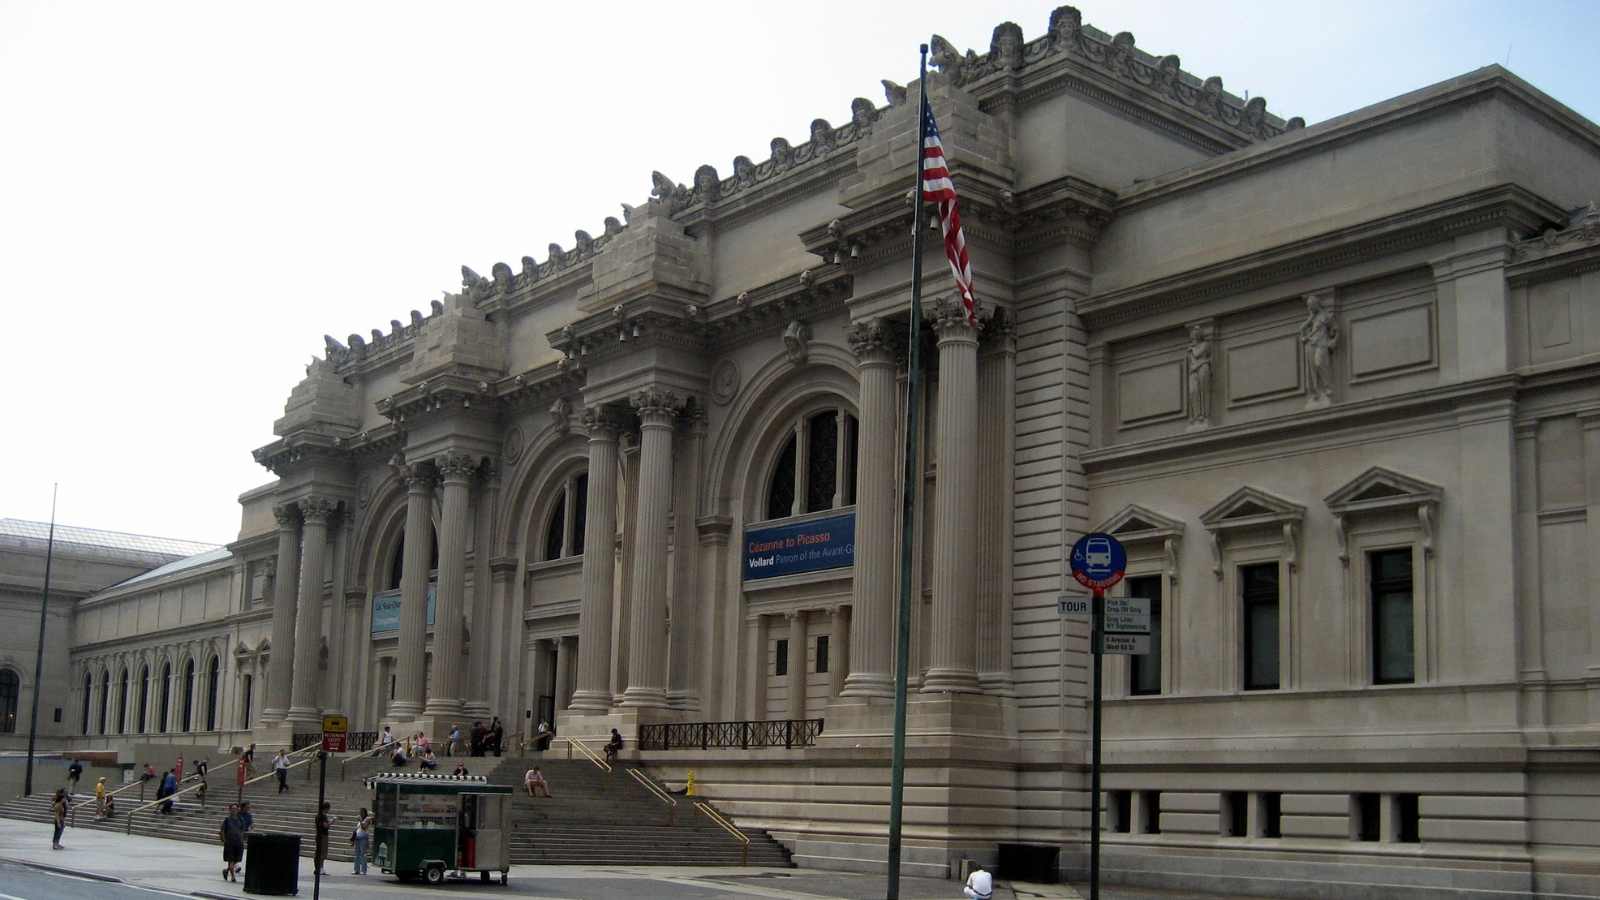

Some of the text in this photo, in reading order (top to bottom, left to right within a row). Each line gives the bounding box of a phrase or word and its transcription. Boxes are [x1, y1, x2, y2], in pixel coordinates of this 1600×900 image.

[786, 537, 795, 547] to
[797, 532, 831, 545] Picasso
[749, 555, 774, 568] Vollard
[1061, 602, 1087, 612] TOUR
